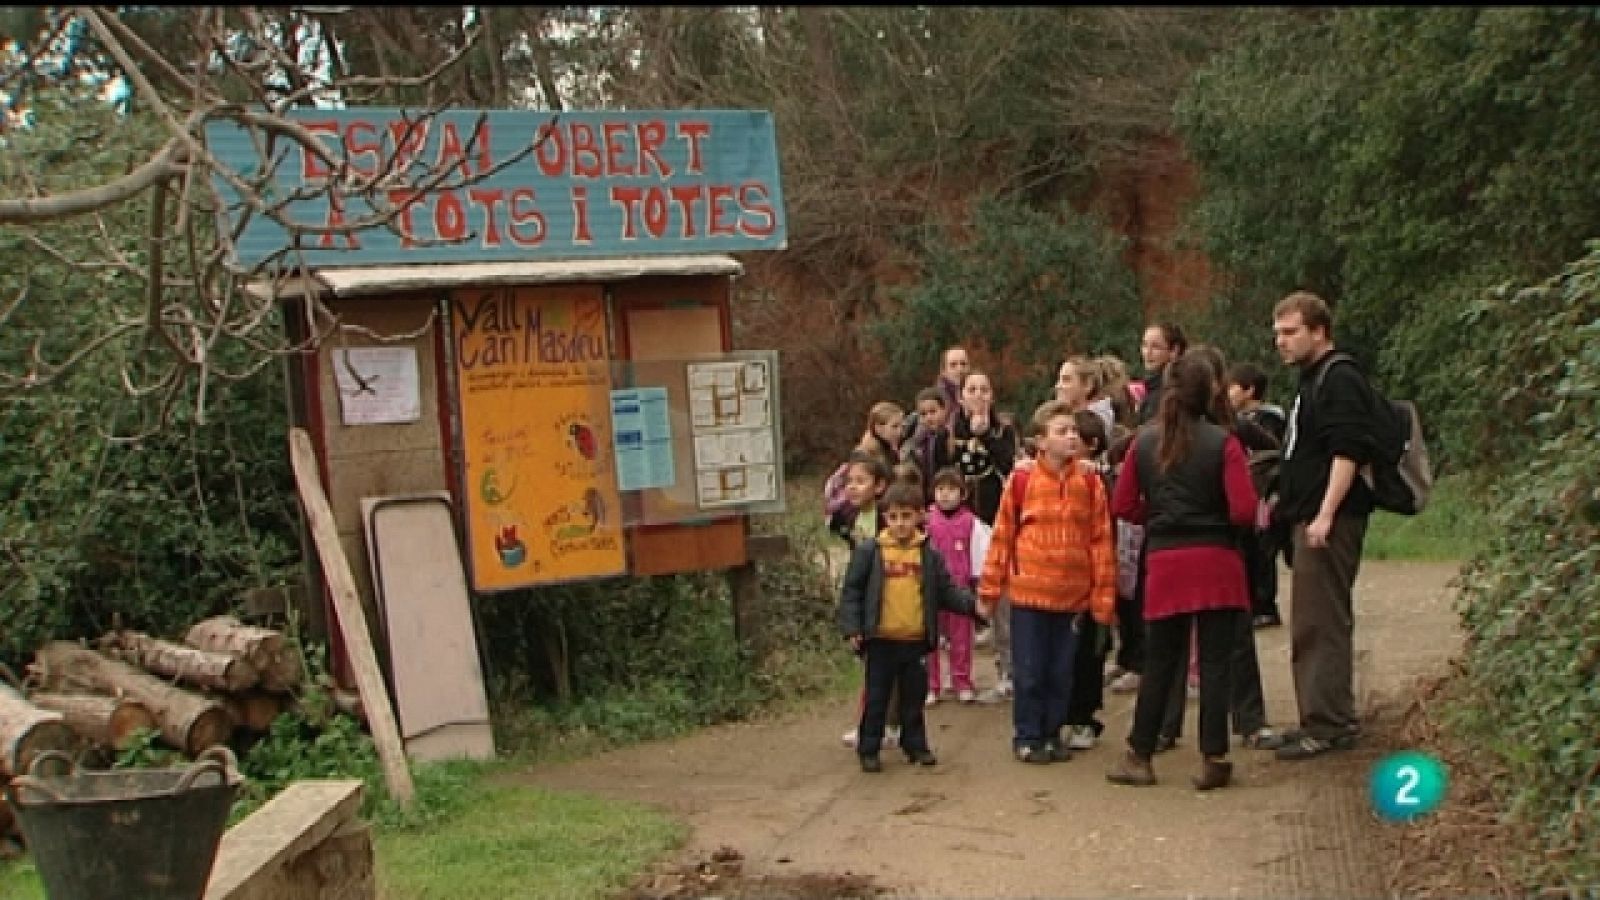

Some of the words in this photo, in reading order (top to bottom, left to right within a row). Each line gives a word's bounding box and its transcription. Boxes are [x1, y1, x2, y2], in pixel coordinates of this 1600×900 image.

[300, 119, 492, 180] ESPAI
[533, 120, 711, 182] OBERT
[387, 186, 547, 249] TOTS
[609, 180, 777, 240] TOTES
[454, 285, 521, 334] Vall
[459, 332, 516, 370] Can
